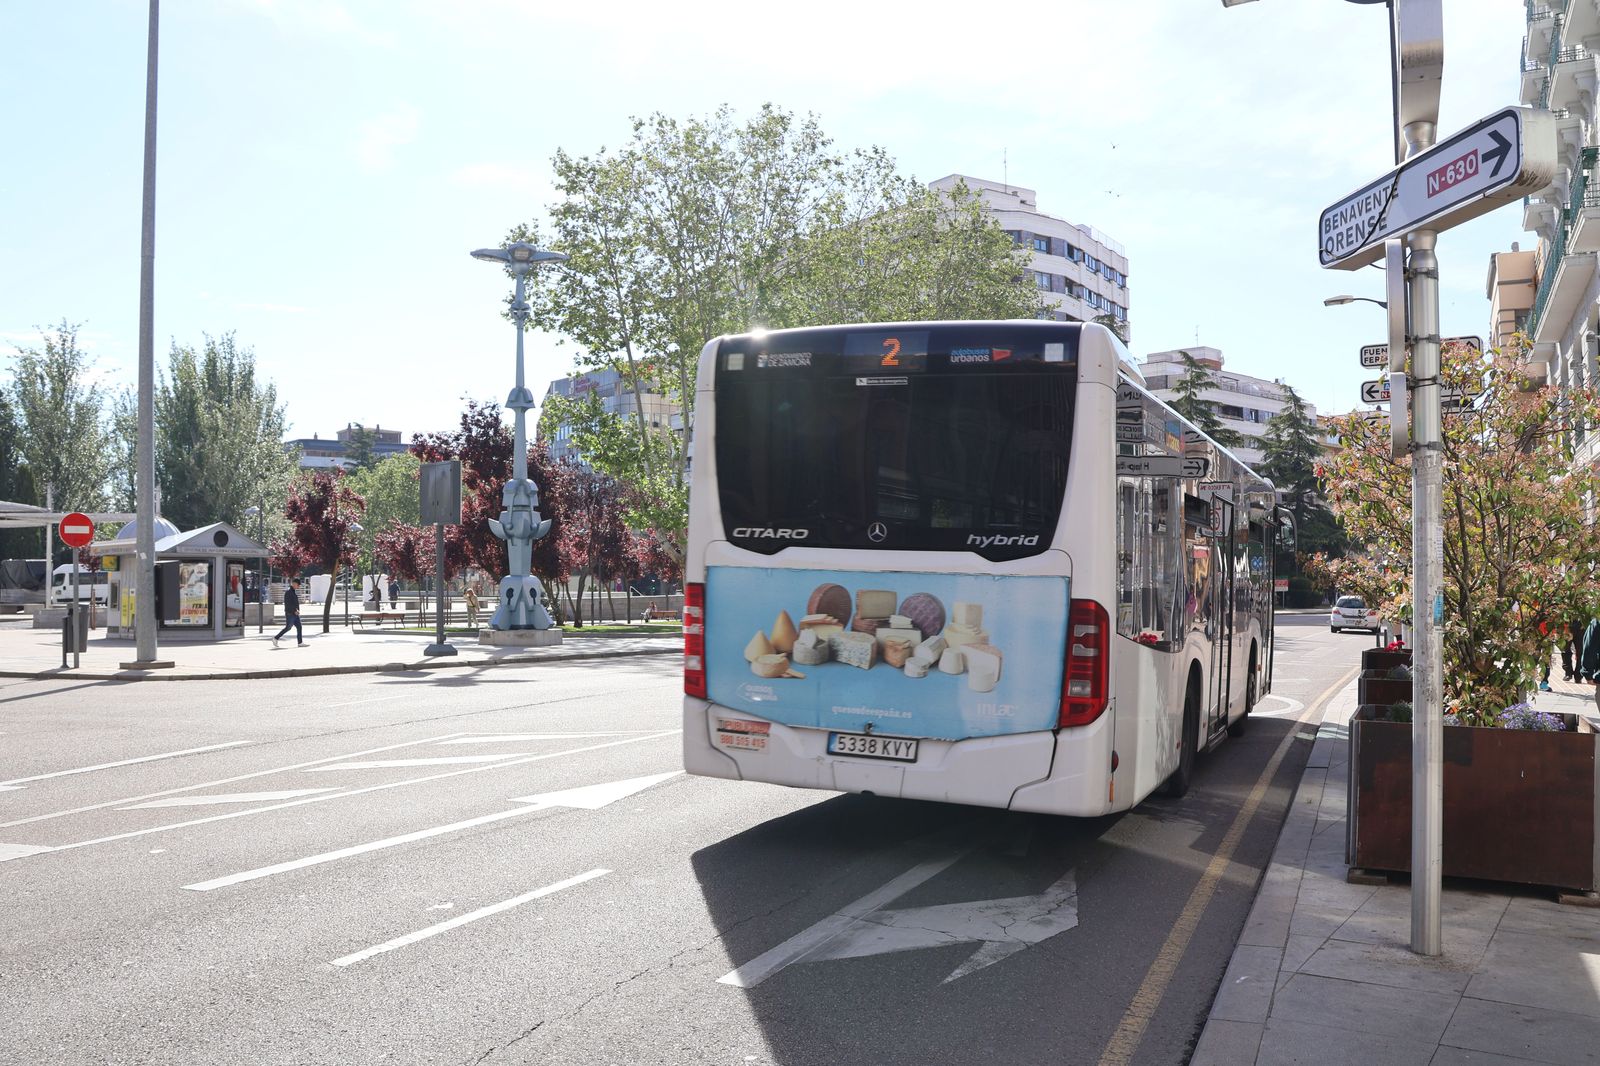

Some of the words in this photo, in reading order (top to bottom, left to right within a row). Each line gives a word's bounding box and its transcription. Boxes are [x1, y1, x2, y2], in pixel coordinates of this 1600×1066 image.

[1427, 153, 1477, 195] N-630
[1323, 182, 1399, 235] BENAVENTE
[1324, 211, 1388, 256] ORENSE
[881, 338, 901, 366] 2
[950, 354, 990, 363] urbanos
[1363, 347, 1388, 357] FUEN
[1363, 356, 1388, 364] FER
[732, 527, 809, 539] CITARO
[966, 533, 1040, 548] hybrid
[838, 736, 877, 754] 5338
[882, 740, 913, 758] KVY
